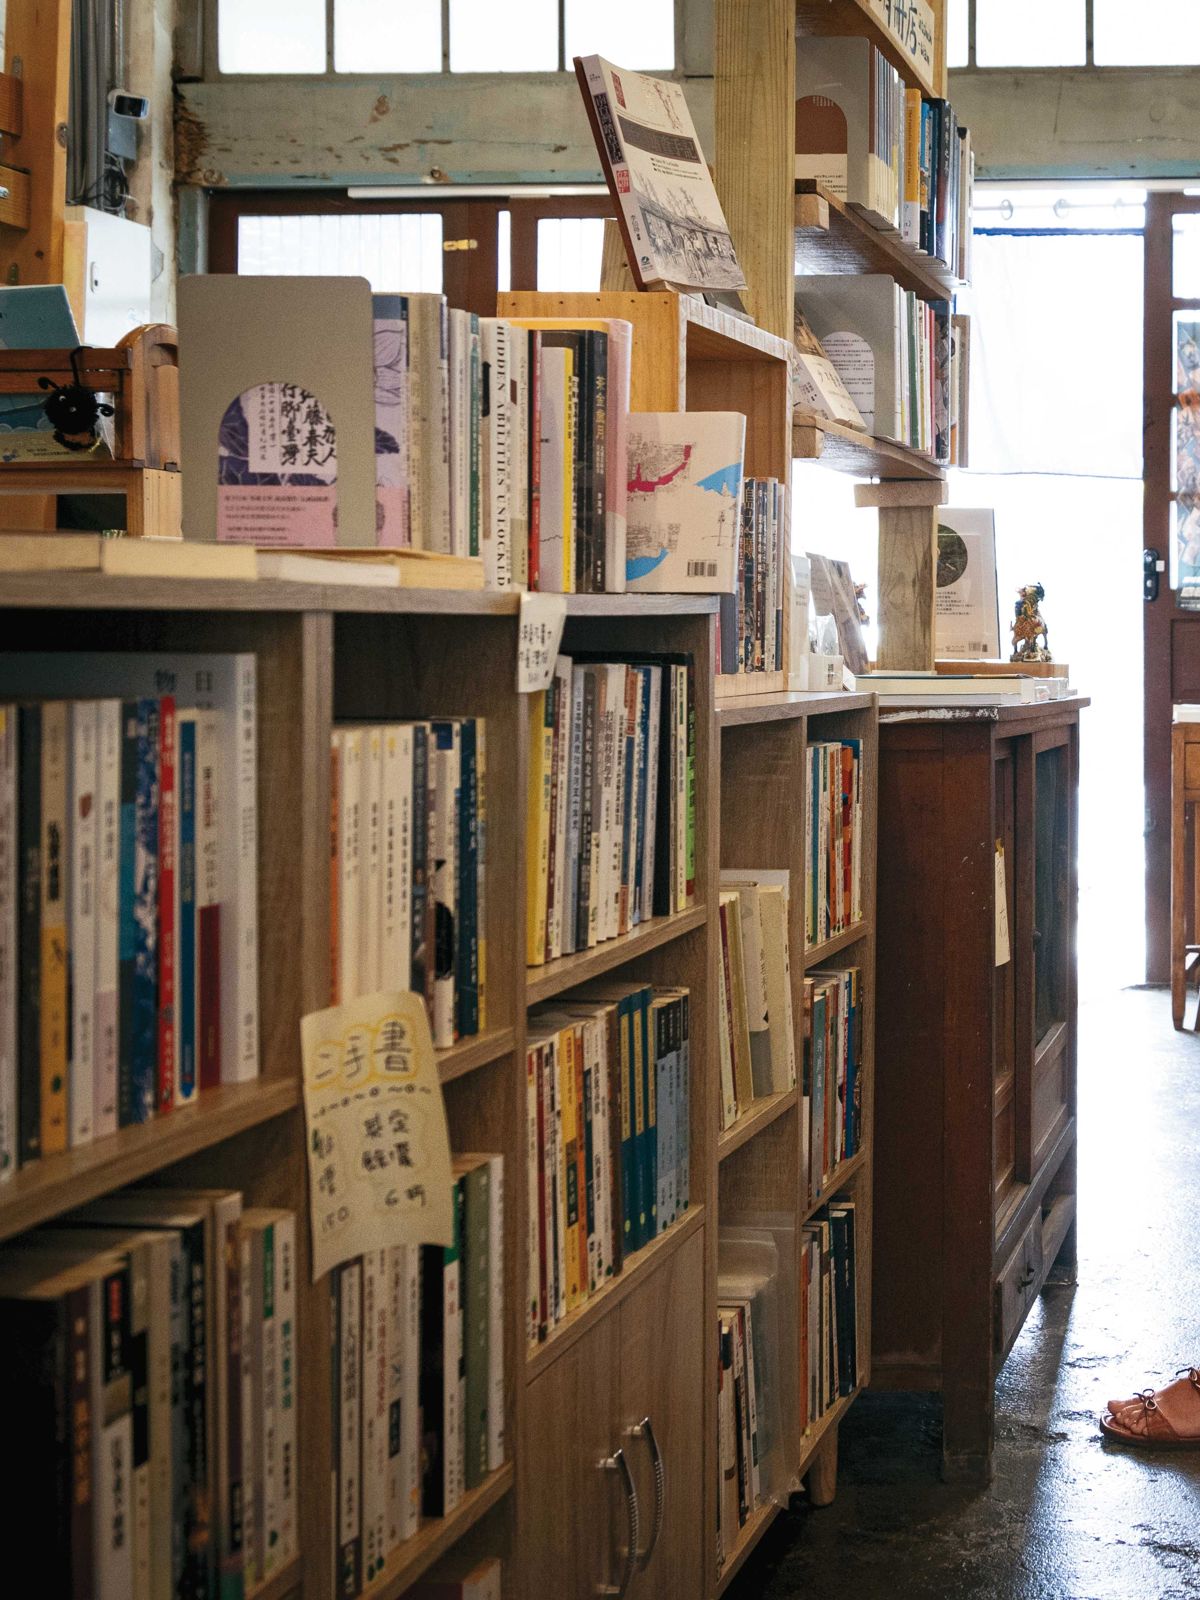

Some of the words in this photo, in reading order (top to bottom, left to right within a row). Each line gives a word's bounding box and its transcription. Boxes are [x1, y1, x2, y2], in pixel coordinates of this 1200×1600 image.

[496, 326, 506, 391] HIDDEN
[496, 403, 506, 487] ABILITIES
[496, 494, 506, 586] UNLOCKED
[315, 1020, 411, 1080] 二手書
